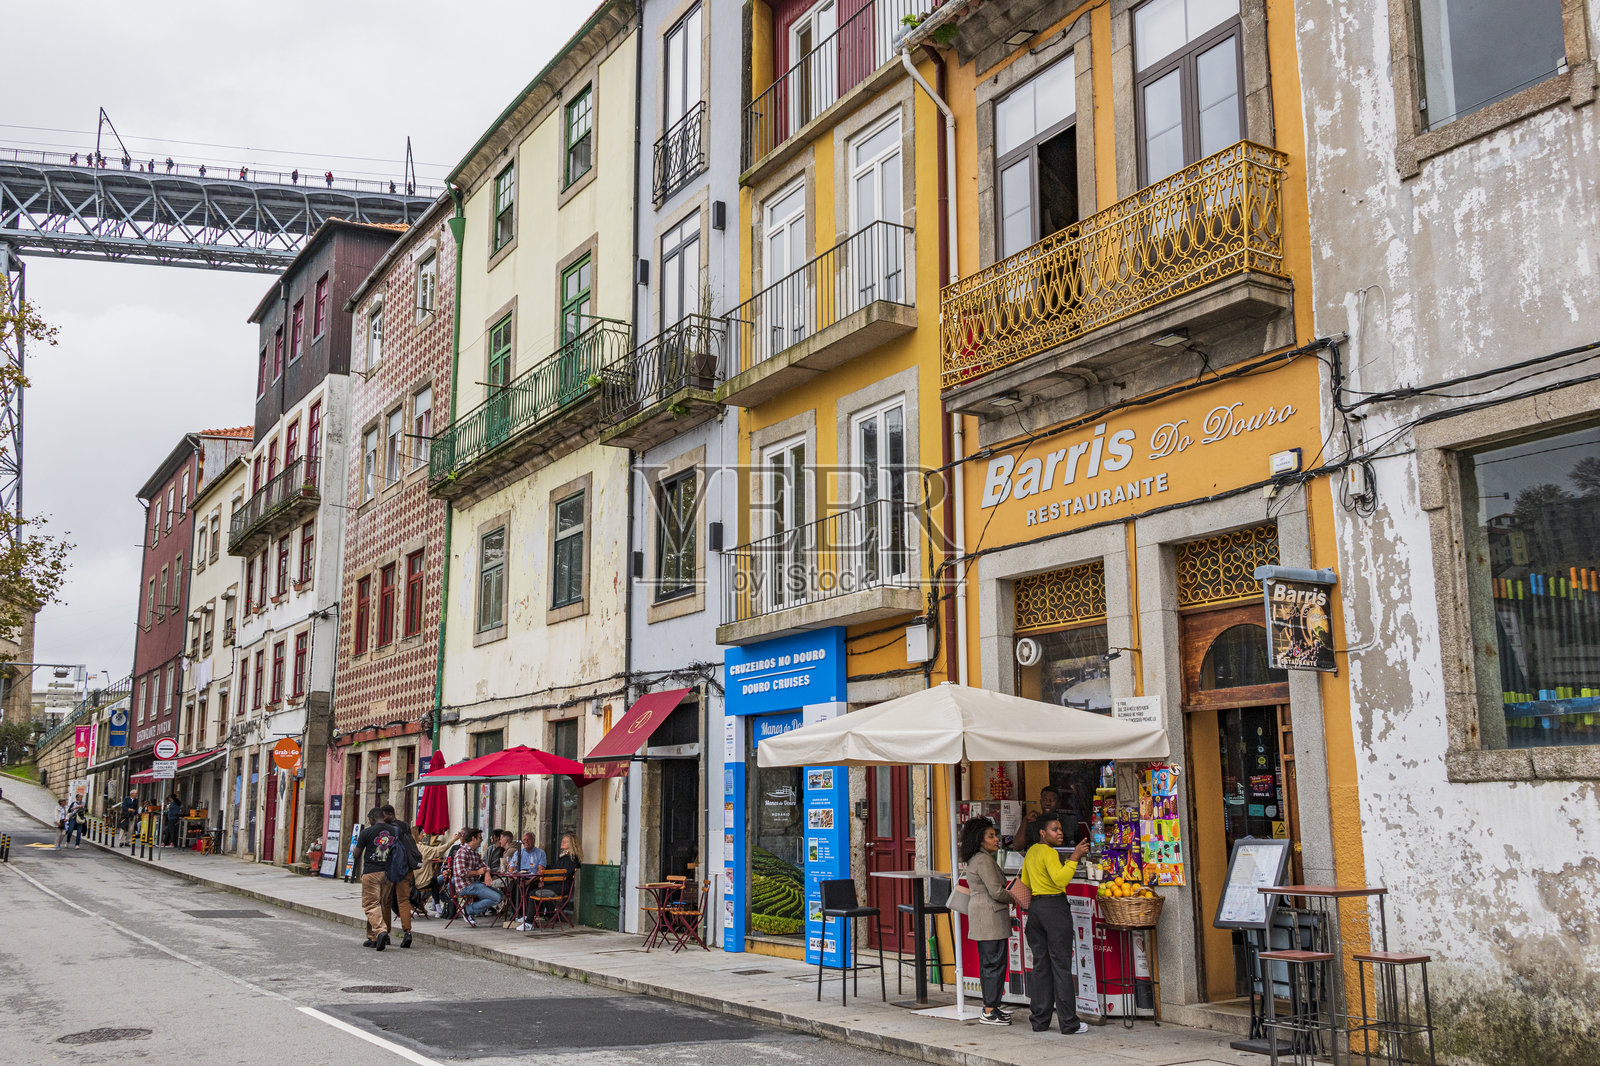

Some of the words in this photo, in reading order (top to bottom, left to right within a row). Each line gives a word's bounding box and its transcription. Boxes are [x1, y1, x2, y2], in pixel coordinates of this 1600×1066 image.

[981, 422, 1136, 509] Barris
[1148, 419, 1195, 460] Do
[1200, 402, 1298, 445] Douro
[1026, 473, 1169, 527] RESTAURANTE
[1273, 583, 1327, 607] Barris
[729, 657, 776, 676] CRUZEIROS
[778, 655, 791, 667] NO
[793, 648, 826, 664] DOURO
[742, 681, 771, 695] DOURO
[772, 674, 810, 690] CRUISES
[761, 722, 783, 736] Manos
